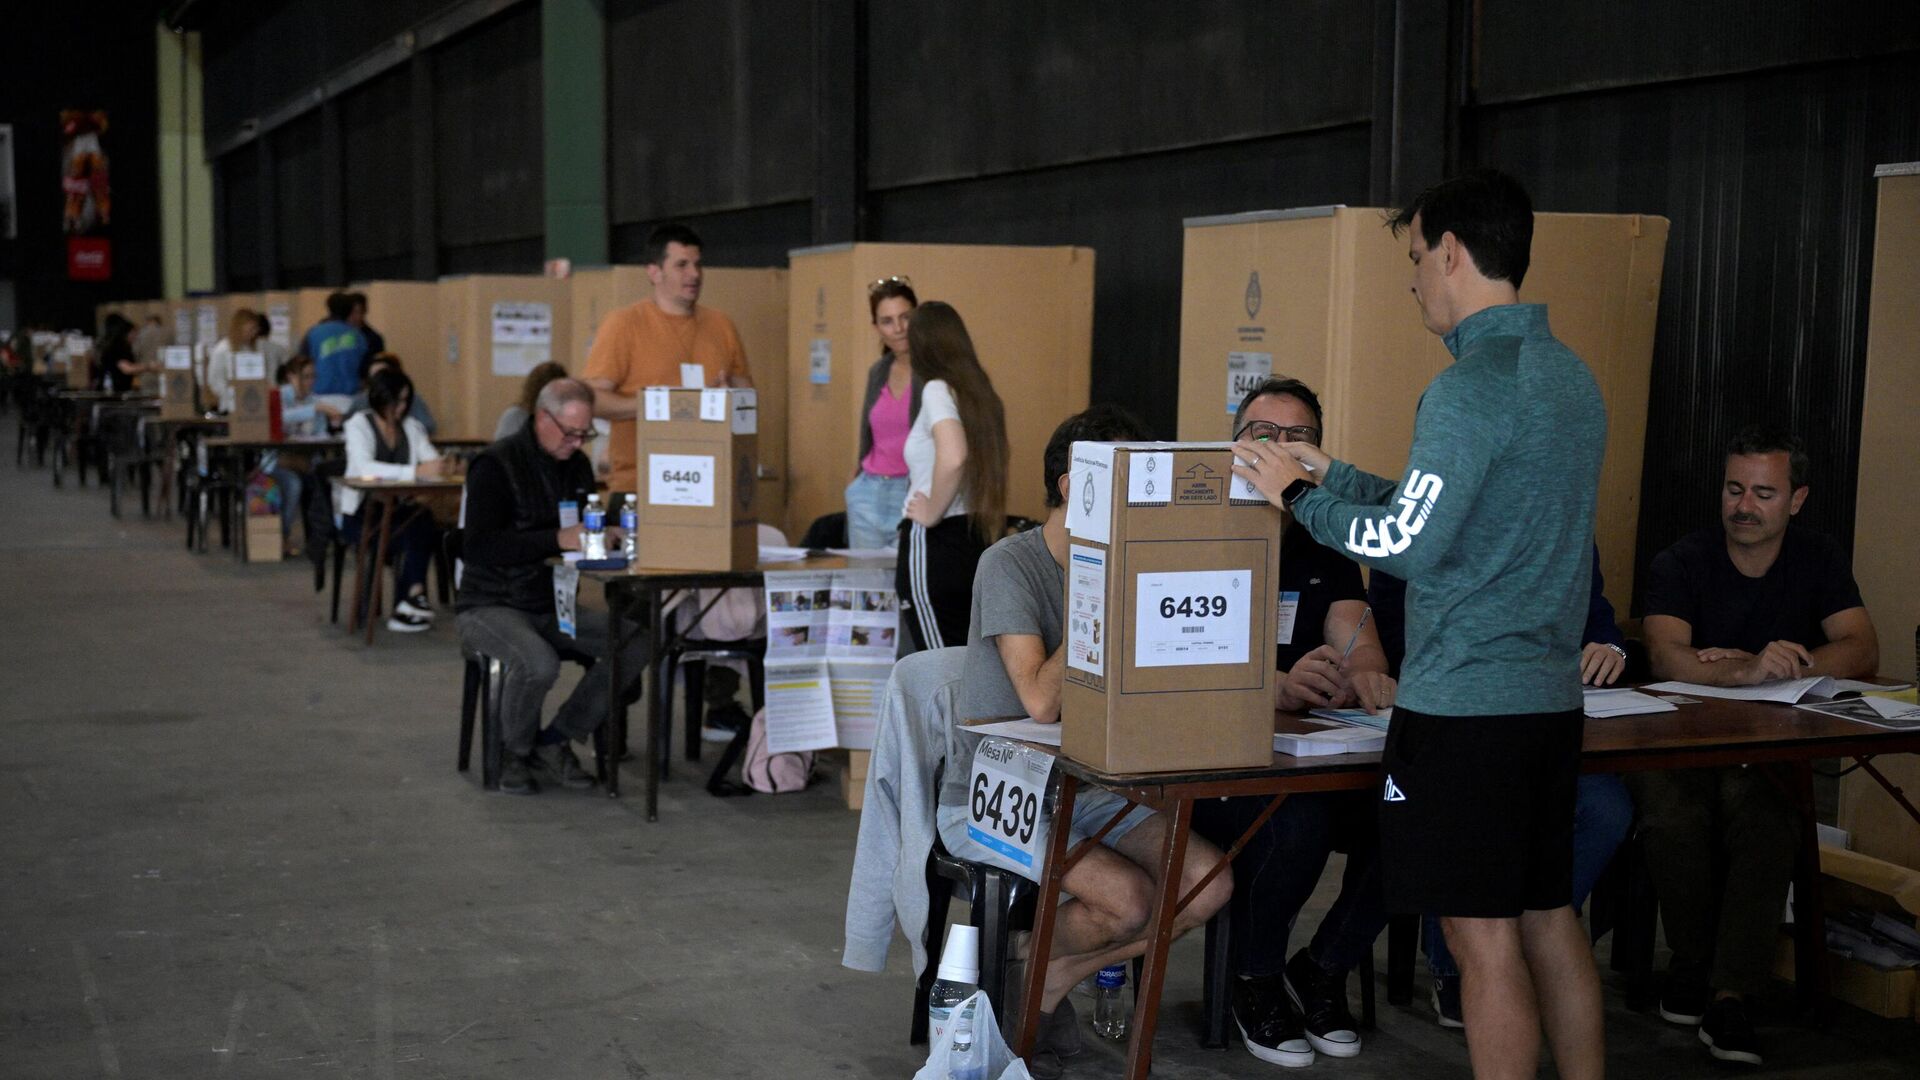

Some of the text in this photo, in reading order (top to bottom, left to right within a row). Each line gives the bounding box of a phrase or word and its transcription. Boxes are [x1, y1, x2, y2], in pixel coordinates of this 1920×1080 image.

[662, 470, 702, 484] 6440
[1344, 469, 1444, 558] SPORT
[1159, 595, 1228, 619] 6439
[978, 741, 1000, 761] Mesa
[972, 772, 1037, 845] 6439
